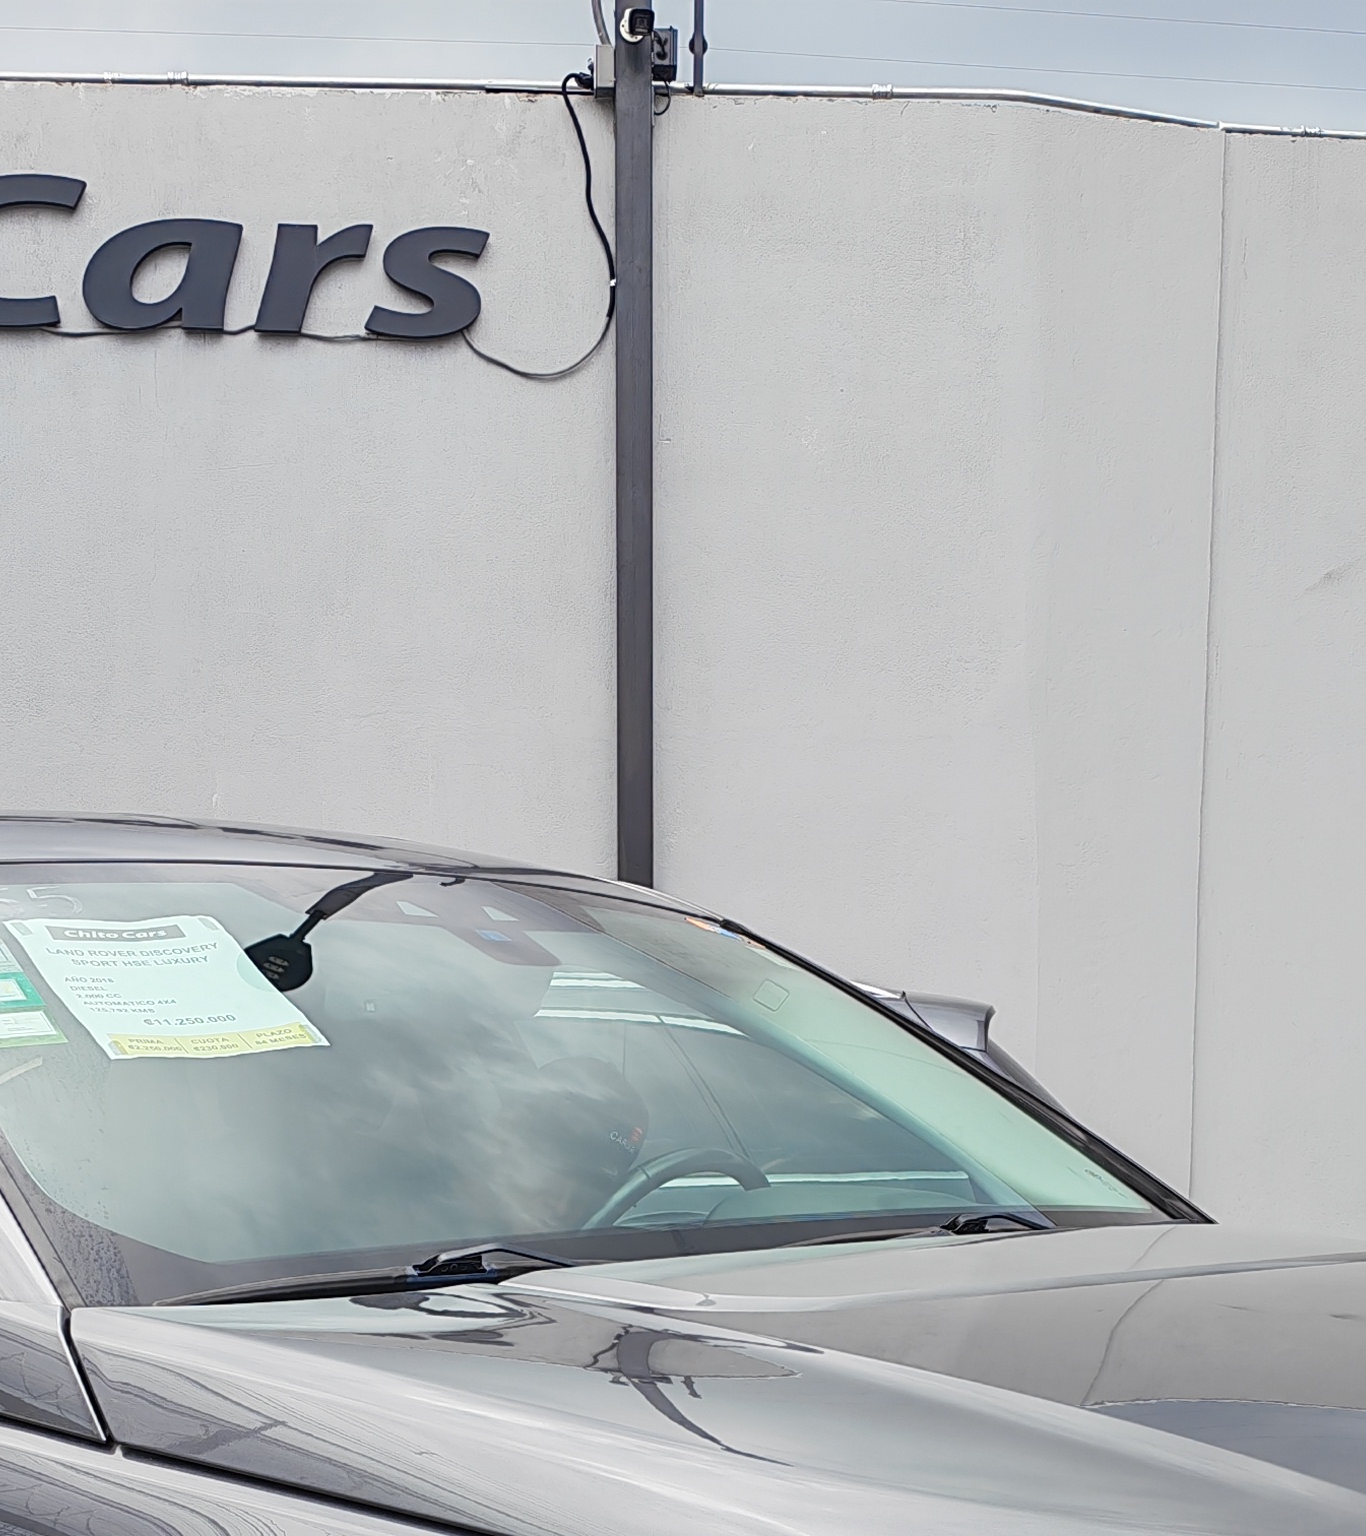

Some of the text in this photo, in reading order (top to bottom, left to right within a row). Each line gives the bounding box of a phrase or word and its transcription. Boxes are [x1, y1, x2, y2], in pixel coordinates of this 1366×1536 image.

[63, 929, 168, 939] Chito Cars
[46, 942, 219, 957] LAND ROVER DISCOVERY
[71, 955, 210, 967] SPORT HSE LUXURY
[64, 975, 88, 983] AÑO
[127, 1037, 164, 1045] PRIMA
